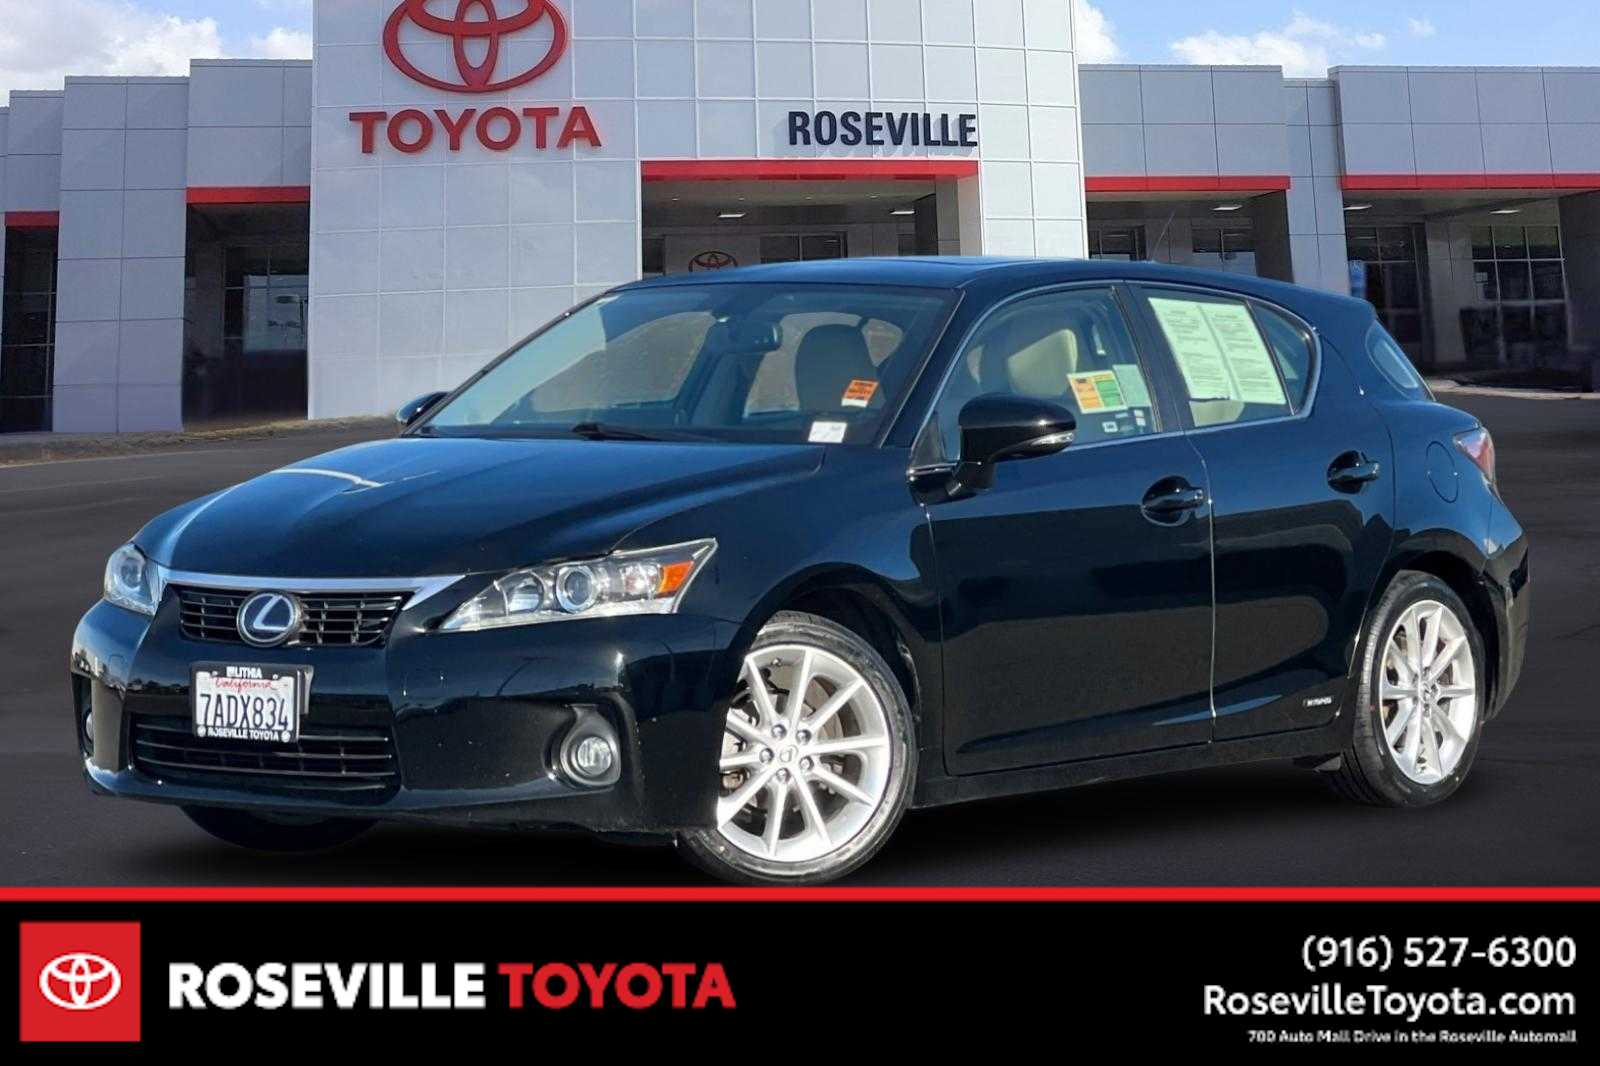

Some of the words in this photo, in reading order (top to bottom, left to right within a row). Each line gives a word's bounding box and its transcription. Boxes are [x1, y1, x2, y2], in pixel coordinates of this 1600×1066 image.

[349, 106, 602, 154] TOYOTA
[788, 111, 978, 147] ROSEVILLE
[236, 667, 263, 679] LITHIA
[214, 680, 274, 693] California
[200, 693, 289, 729] 7ADX834
[207, 727, 249, 739] ROSEVILLE
[249, 730, 279, 741] TOYOTA
